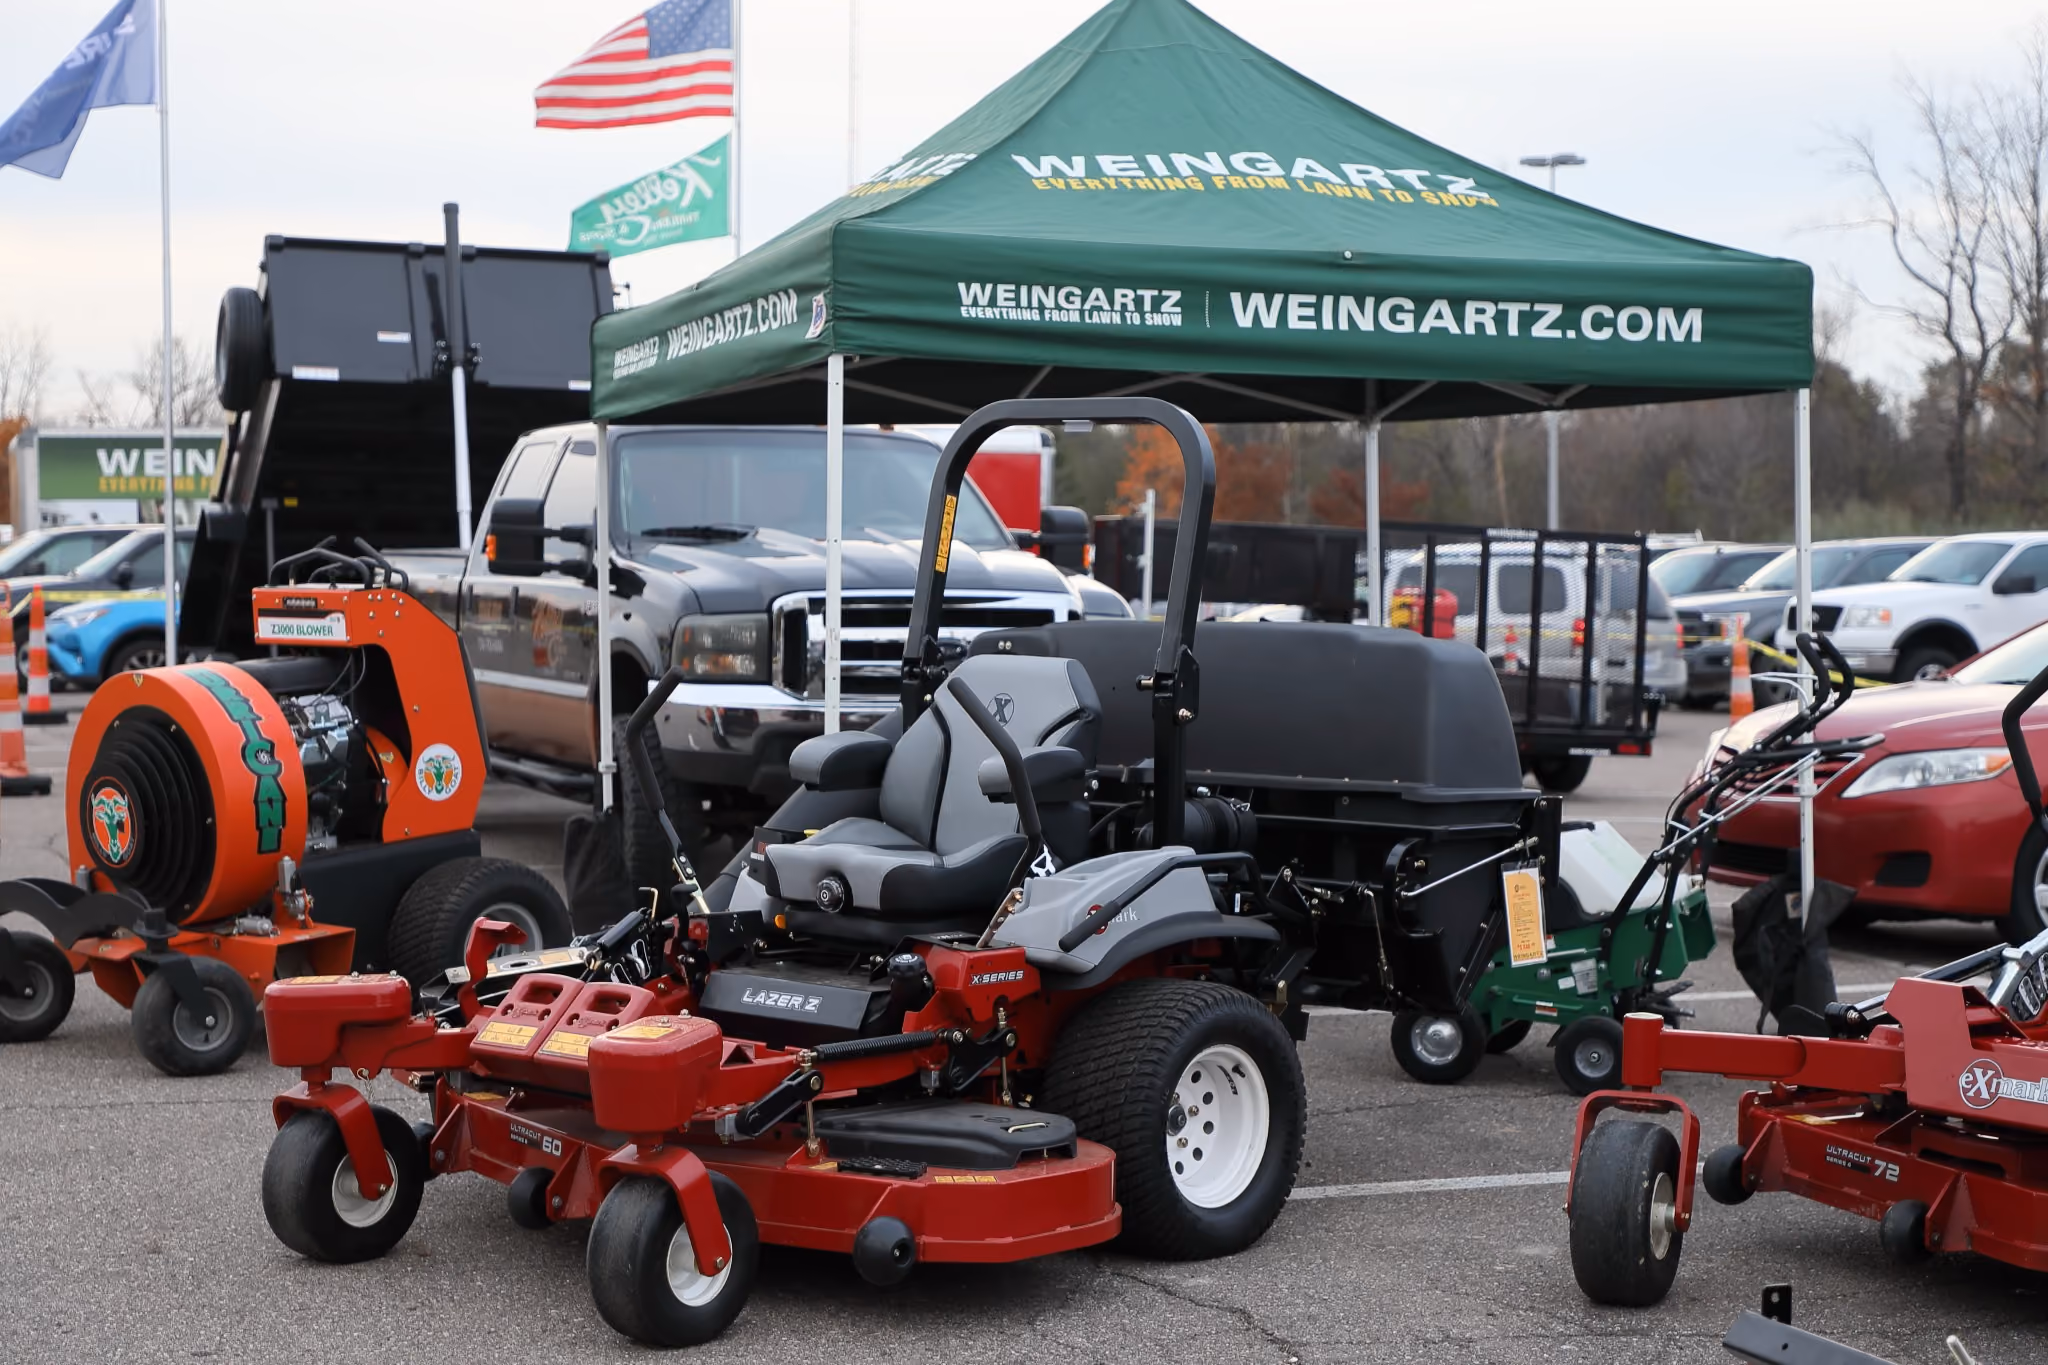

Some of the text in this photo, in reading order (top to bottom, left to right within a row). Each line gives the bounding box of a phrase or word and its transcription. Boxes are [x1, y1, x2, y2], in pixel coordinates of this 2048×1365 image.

[1011, 152, 1490, 199] WEINGARTZ
[1032, 176, 1204, 191] EVERYTHING
[1212, 175, 1290, 190] FROM
[1298, 180, 1374, 202] LAWN
[1378, 189, 1414, 203] TO
[957, 282, 1182, 313] WEINGARTZ
[667, 289, 798, 360] WEINGARTZ.COM
[960, 306, 1182, 326] EVERYTHING FROM LAWN TO SNOW
[1230, 292, 1703, 342] WEINGARTZ.COM
[614, 336, 659, 369] WEINGARTZ
[99, 476, 195, 493] EVERYTHNG
[297, 625, 334, 636] BLOWER
[444, 767, 459, 795] GOAT
[971, 970, 1024, 985] X-SERIES
[741, 988, 822, 1012] LAZER Z
[510, 1123, 562, 1156] ULTRACUT 60
[1826, 1144, 1899, 1182] ULTRACUT 72
